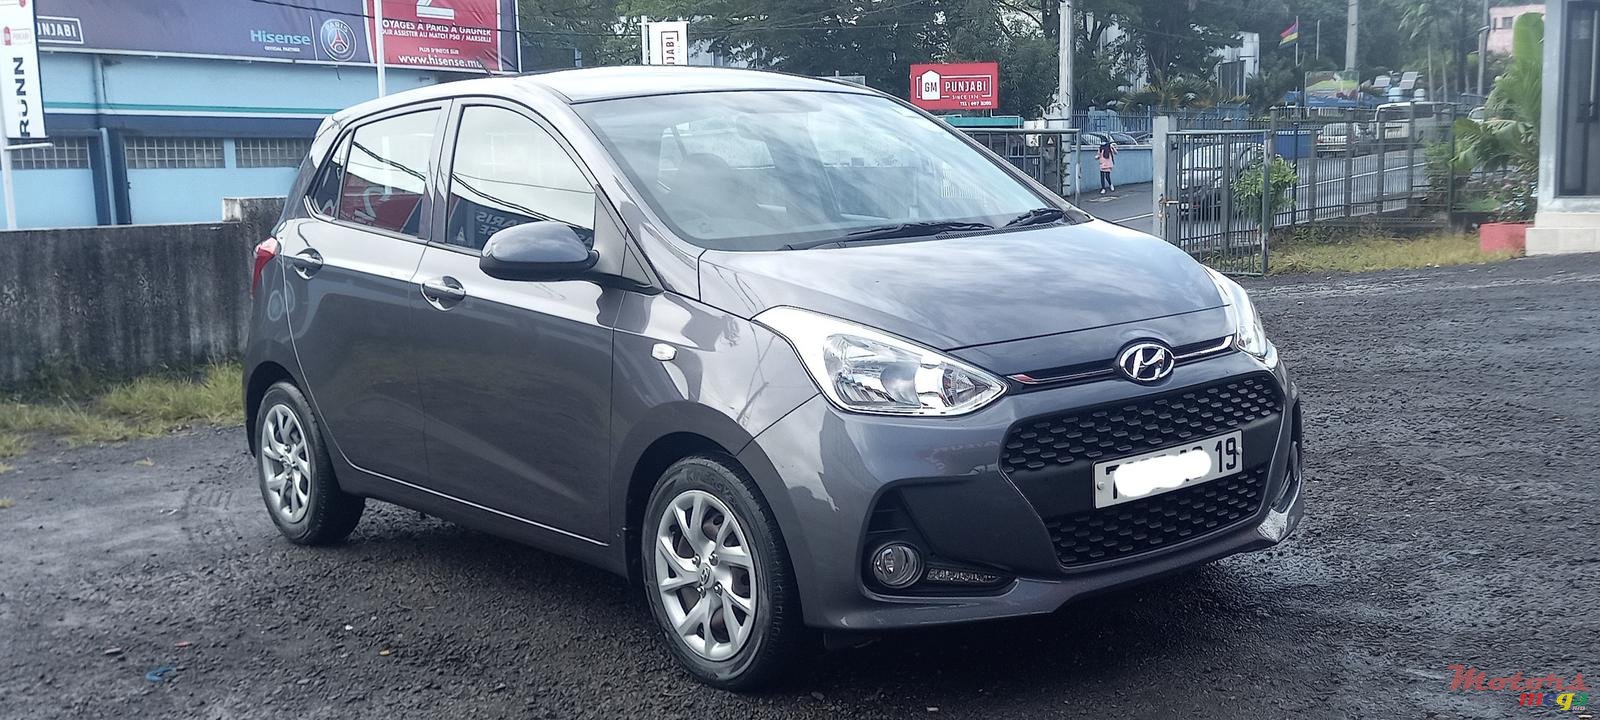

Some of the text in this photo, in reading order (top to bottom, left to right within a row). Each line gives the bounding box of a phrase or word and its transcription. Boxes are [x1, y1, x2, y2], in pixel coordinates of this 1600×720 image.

[37, 22, 77, 37] NJABI
[382, 20, 415, 30] OYAGES
[250, 30, 311, 45] Hisense
[665, 37, 675, 65] JABI
[924, 80, 987, 92] GM PUNJABI
[1215, 437, 1237, 473] 19
